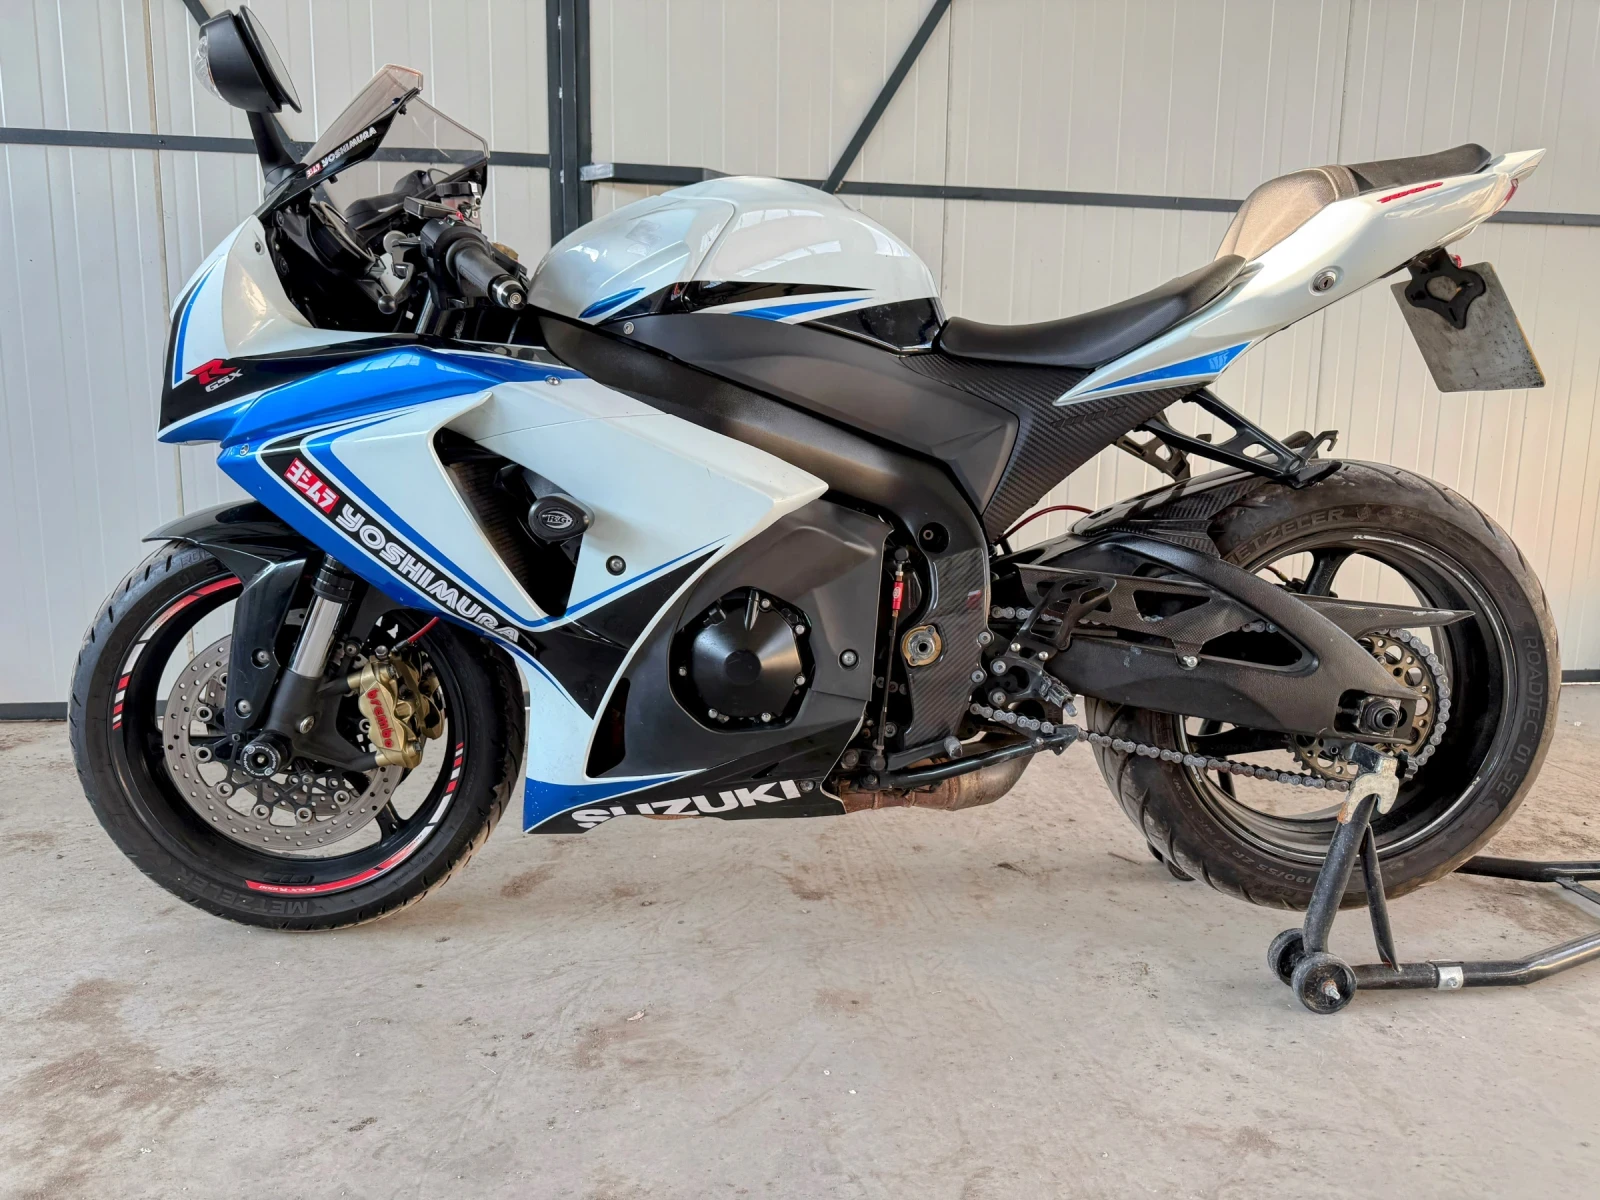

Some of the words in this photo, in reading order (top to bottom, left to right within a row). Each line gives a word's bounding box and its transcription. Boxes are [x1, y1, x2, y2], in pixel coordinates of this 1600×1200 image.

[321, 126, 378, 167] YOSHIMURA
[205, 369, 243, 392] GSX
[286, 458, 338, 513] ヨシムラ
[335, 503, 519, 642] YOSHIMURA
[367, 688, 394, 749] brembo
[1496, 768, 1519, 797] SE
[176, 866, 309, 915] METZELER
[1256, 863, 1313, 885] 190/55
